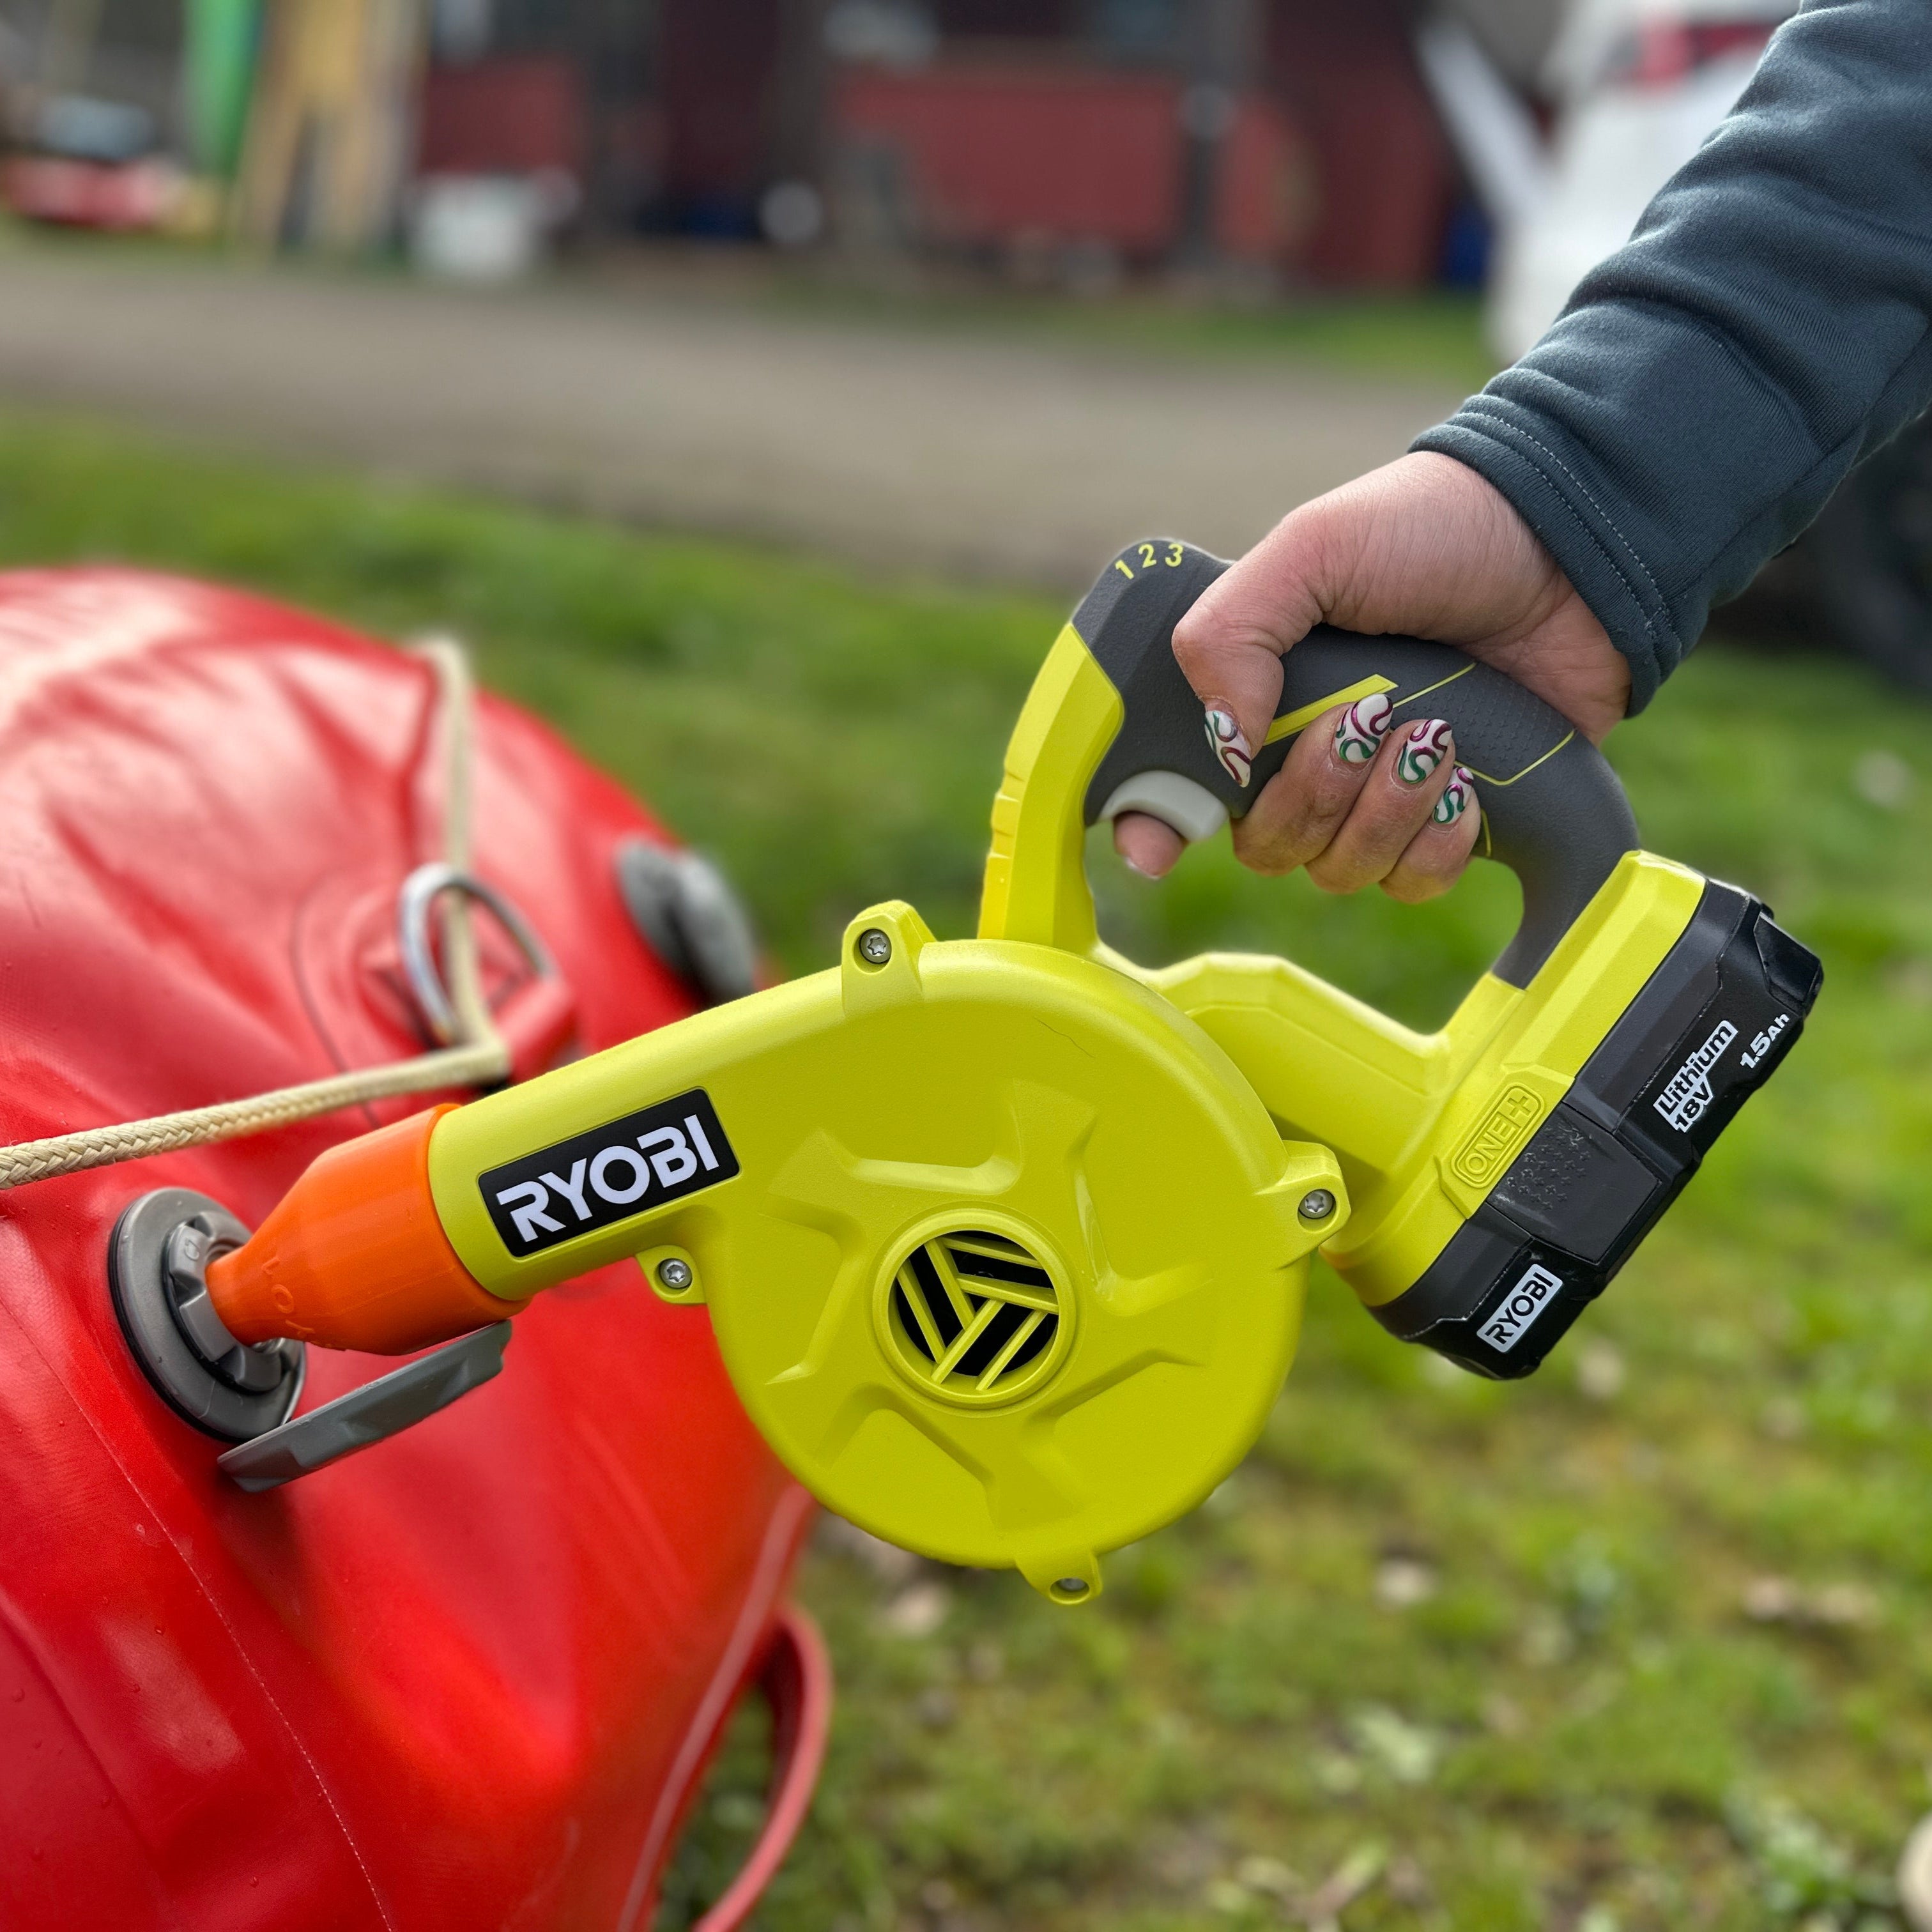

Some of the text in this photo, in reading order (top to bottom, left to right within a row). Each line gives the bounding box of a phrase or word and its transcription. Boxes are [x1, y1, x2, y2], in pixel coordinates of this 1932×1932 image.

[1115, 544, 1184, 579] 1 2 3
[1657, 1025, 1733, 1116] Lithium
[1740, 1013, 1790, 1069] 1.5Ah
[1675, 1080, 1710, 1128] 18V
[495, 1114, 719, 1243] RYOBI
[1484, 1271, 1554, 1345] RYOBI
